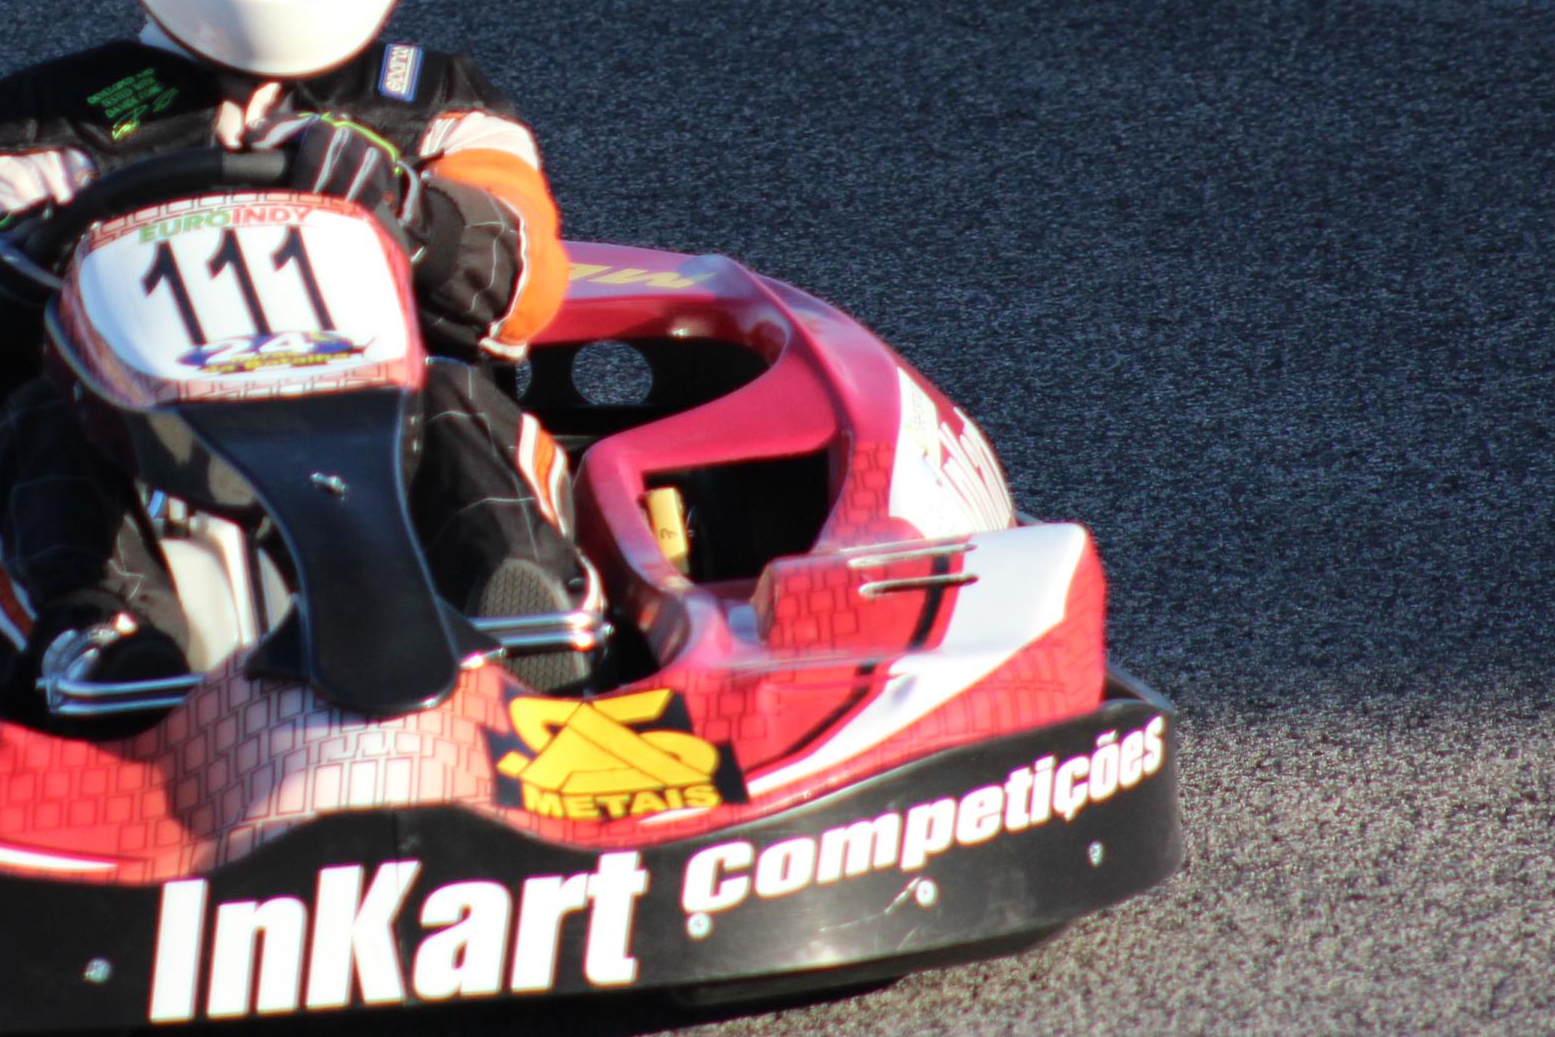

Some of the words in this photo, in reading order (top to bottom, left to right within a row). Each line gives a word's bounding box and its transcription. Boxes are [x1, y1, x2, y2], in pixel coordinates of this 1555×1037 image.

[139, 207, 312, 242] EUROINDY
[141, 224, 336, 346] 111
[200, 331, 315, 364] 24
[522, 784, 722, 820] METAIS
[149, 851, 650, 1024] InKart
[681, 715, 1166, 914] Competições
